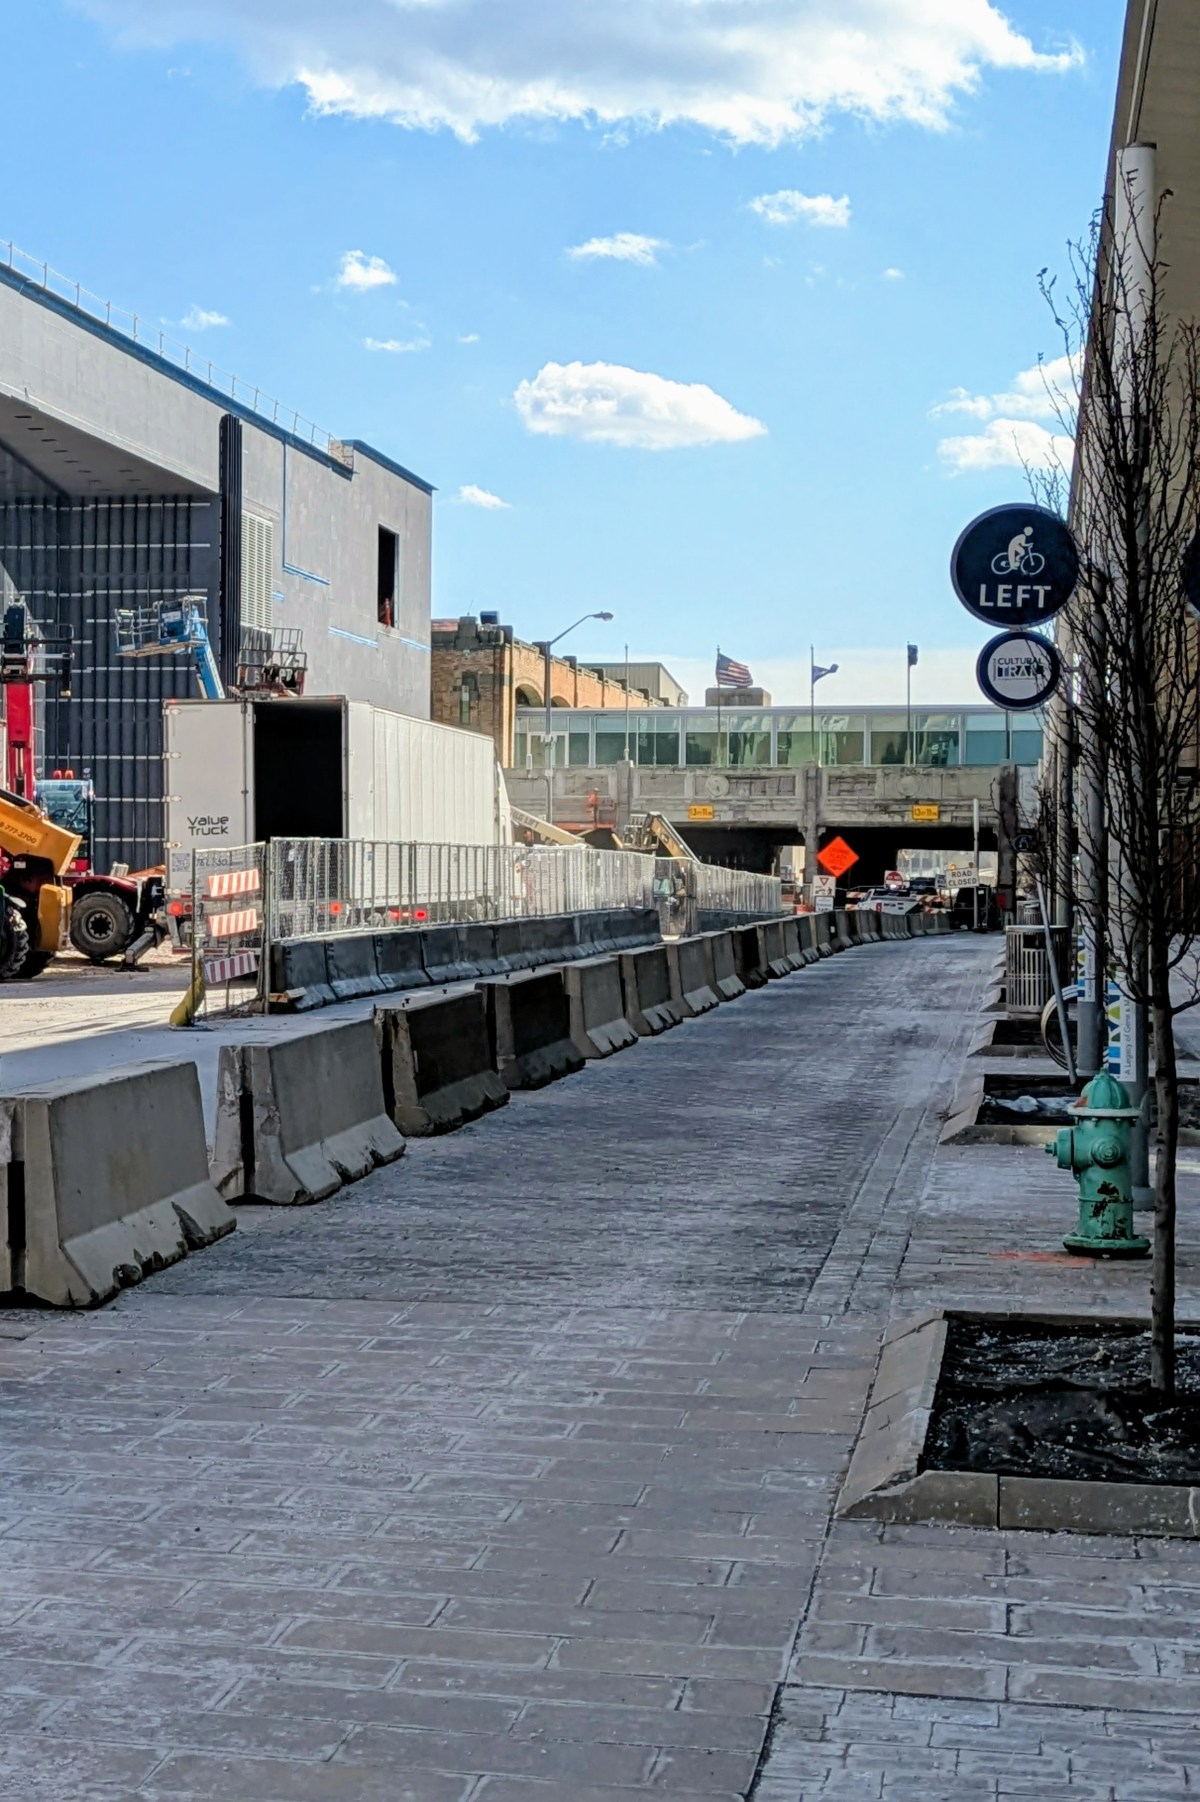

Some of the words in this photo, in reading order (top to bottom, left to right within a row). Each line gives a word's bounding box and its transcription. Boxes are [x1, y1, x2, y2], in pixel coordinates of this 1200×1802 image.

[979, 583, 1052, 609] LEFT
[187, 815, 229, 826] Value
[188, 825, 229, 836] Truck
[951, 870, 972, 878] ROAD
[948, 878, 977, 886] CLOSED
[1123, 1043, 1133, 1067] Legacy
